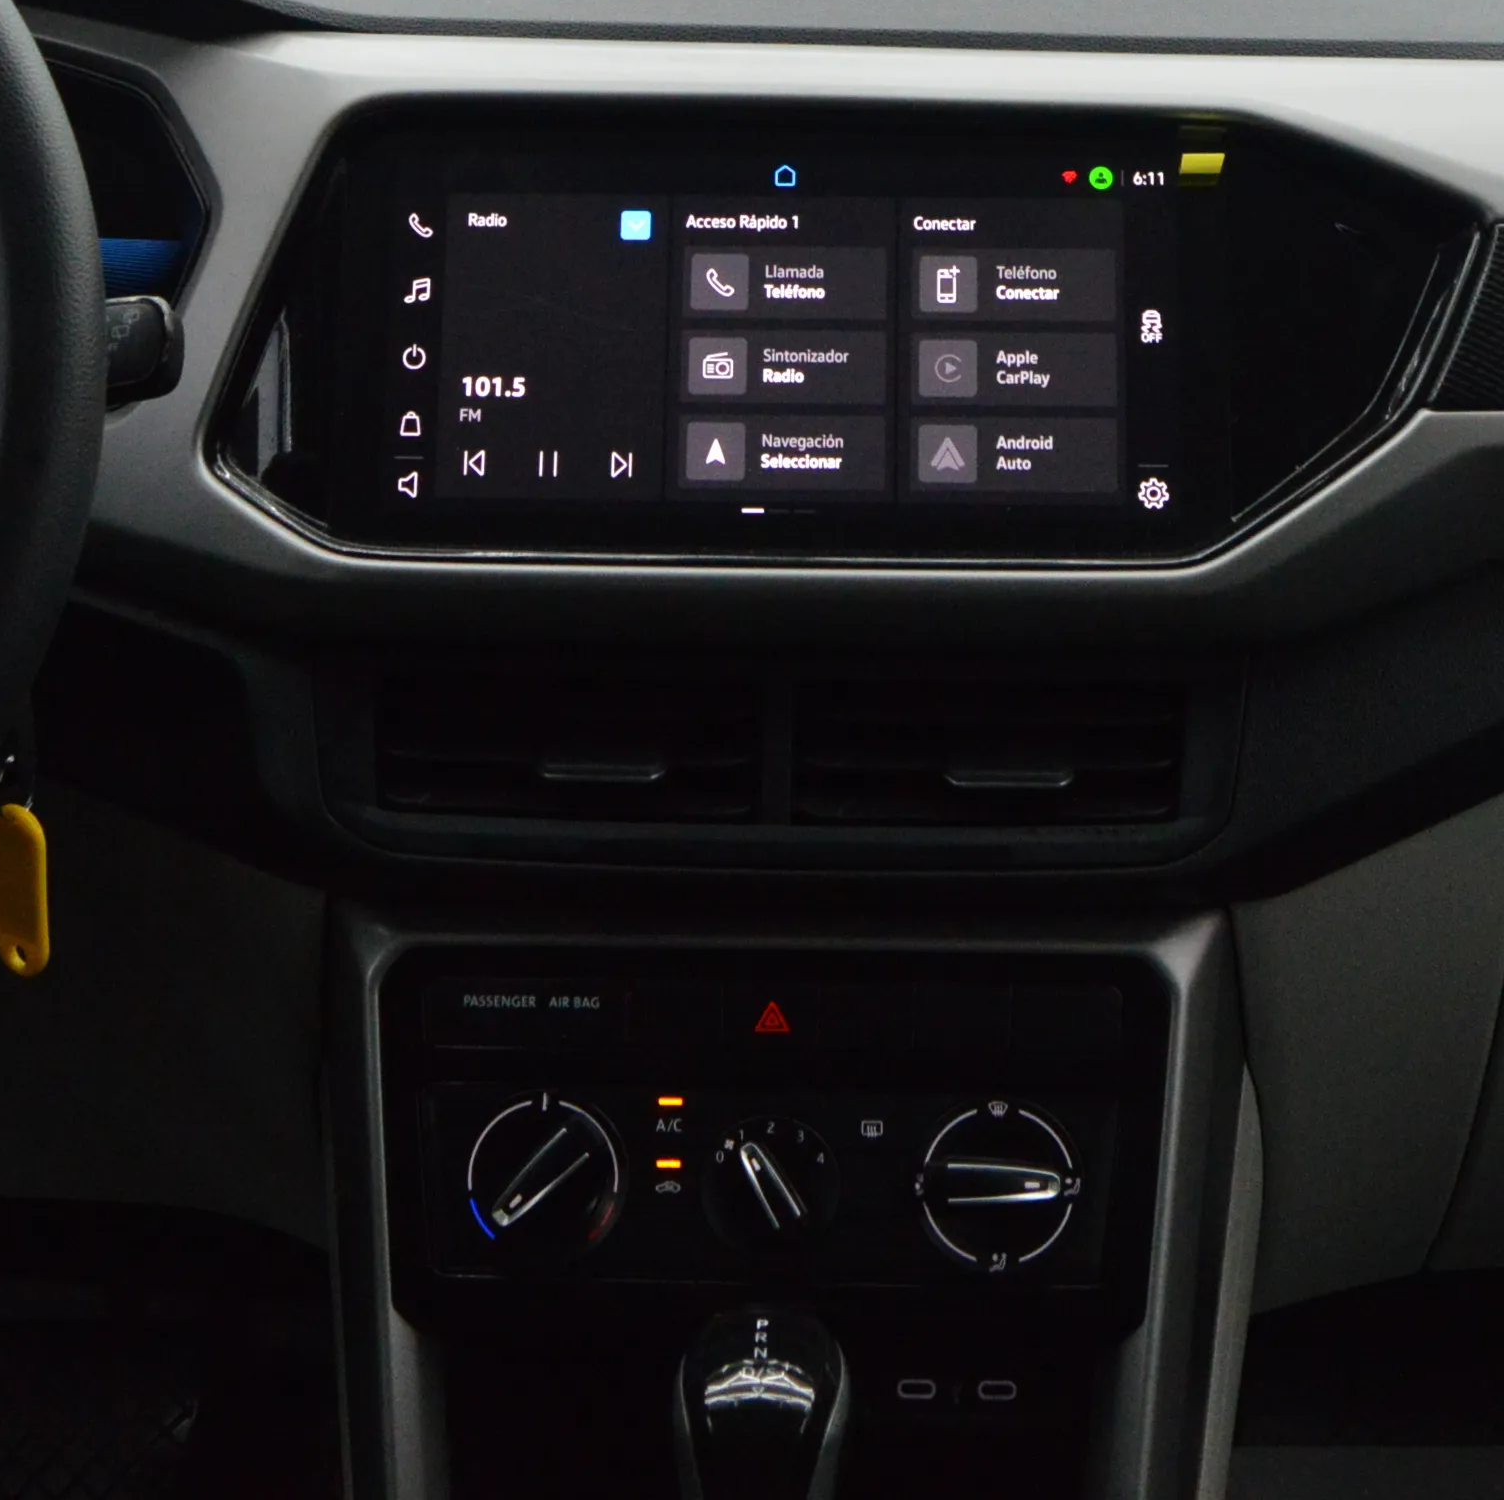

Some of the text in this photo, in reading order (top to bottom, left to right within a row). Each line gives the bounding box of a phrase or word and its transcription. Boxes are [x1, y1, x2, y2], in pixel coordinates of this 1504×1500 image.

[1132, 171, 1165, 186] 6:11
[467, 212, 508, 228] Radio
[685, 214, 799, 233] Acceso Rápido 1
[913, 215, 977, 232] Conectar
[765, 264, 825, 279] Llamada
[996, 265, 1057, 281] Teléfono
[763, 283, 826, 300] Teléfono
[995, 284, 1060, 301] Conectar
[763, 348, 850, 364] Sintonizador
[995, 350, 1039, 368] Apple
[762, 367, 805, 384] Radio
[996, 370, 1051, 389] CarPlay
[462, 375, 526, 398] 101.5
[459, 408, 482, 423] FM
[761, 433, 844, 452] Navegación
[995, 435, 1054, 451] Android
[760, 453, 843, 471] Seleccionar
[996, 455, 1032, 471] Auto
[463, 994, 600, 1009] PASSENGER AIR BAG
[655, 1118, 682, 1133] A/C
[766, 1121, 775, 1134] 2
[798, 1129, 805, 1142] 3
[816, 1152, 825, 1164] 4
[756, 1319, 769, 1330] P
[754, 1332, 768, 1343] R
[753, 1347, 768, 1359] N
